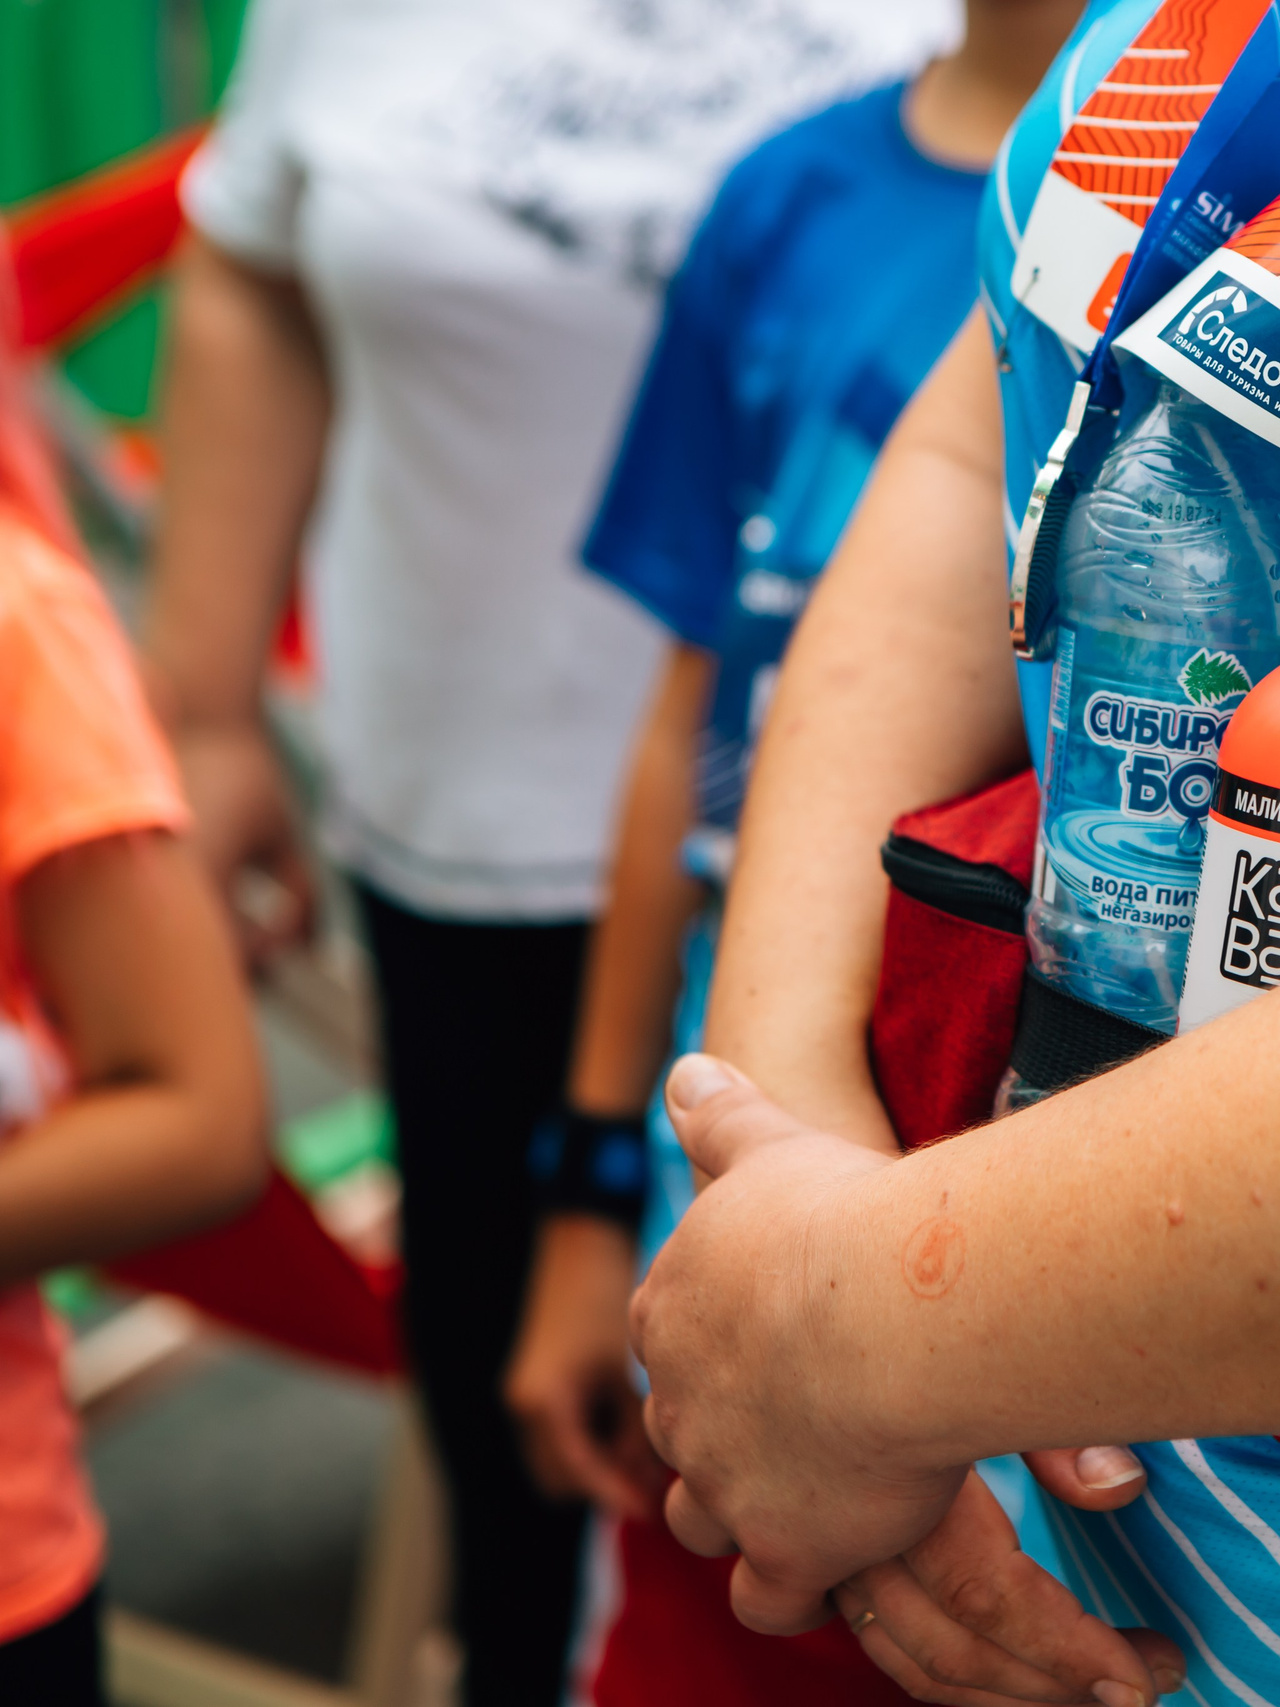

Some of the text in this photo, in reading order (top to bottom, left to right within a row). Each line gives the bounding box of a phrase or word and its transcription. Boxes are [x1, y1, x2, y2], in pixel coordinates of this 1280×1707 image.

[1172, 333, 1203, 360] ТОВАРЫ
[1203, 354, 1225, 374] ДЛЯ
[1225, 369, 1271, 406] ТУРИЗМА
